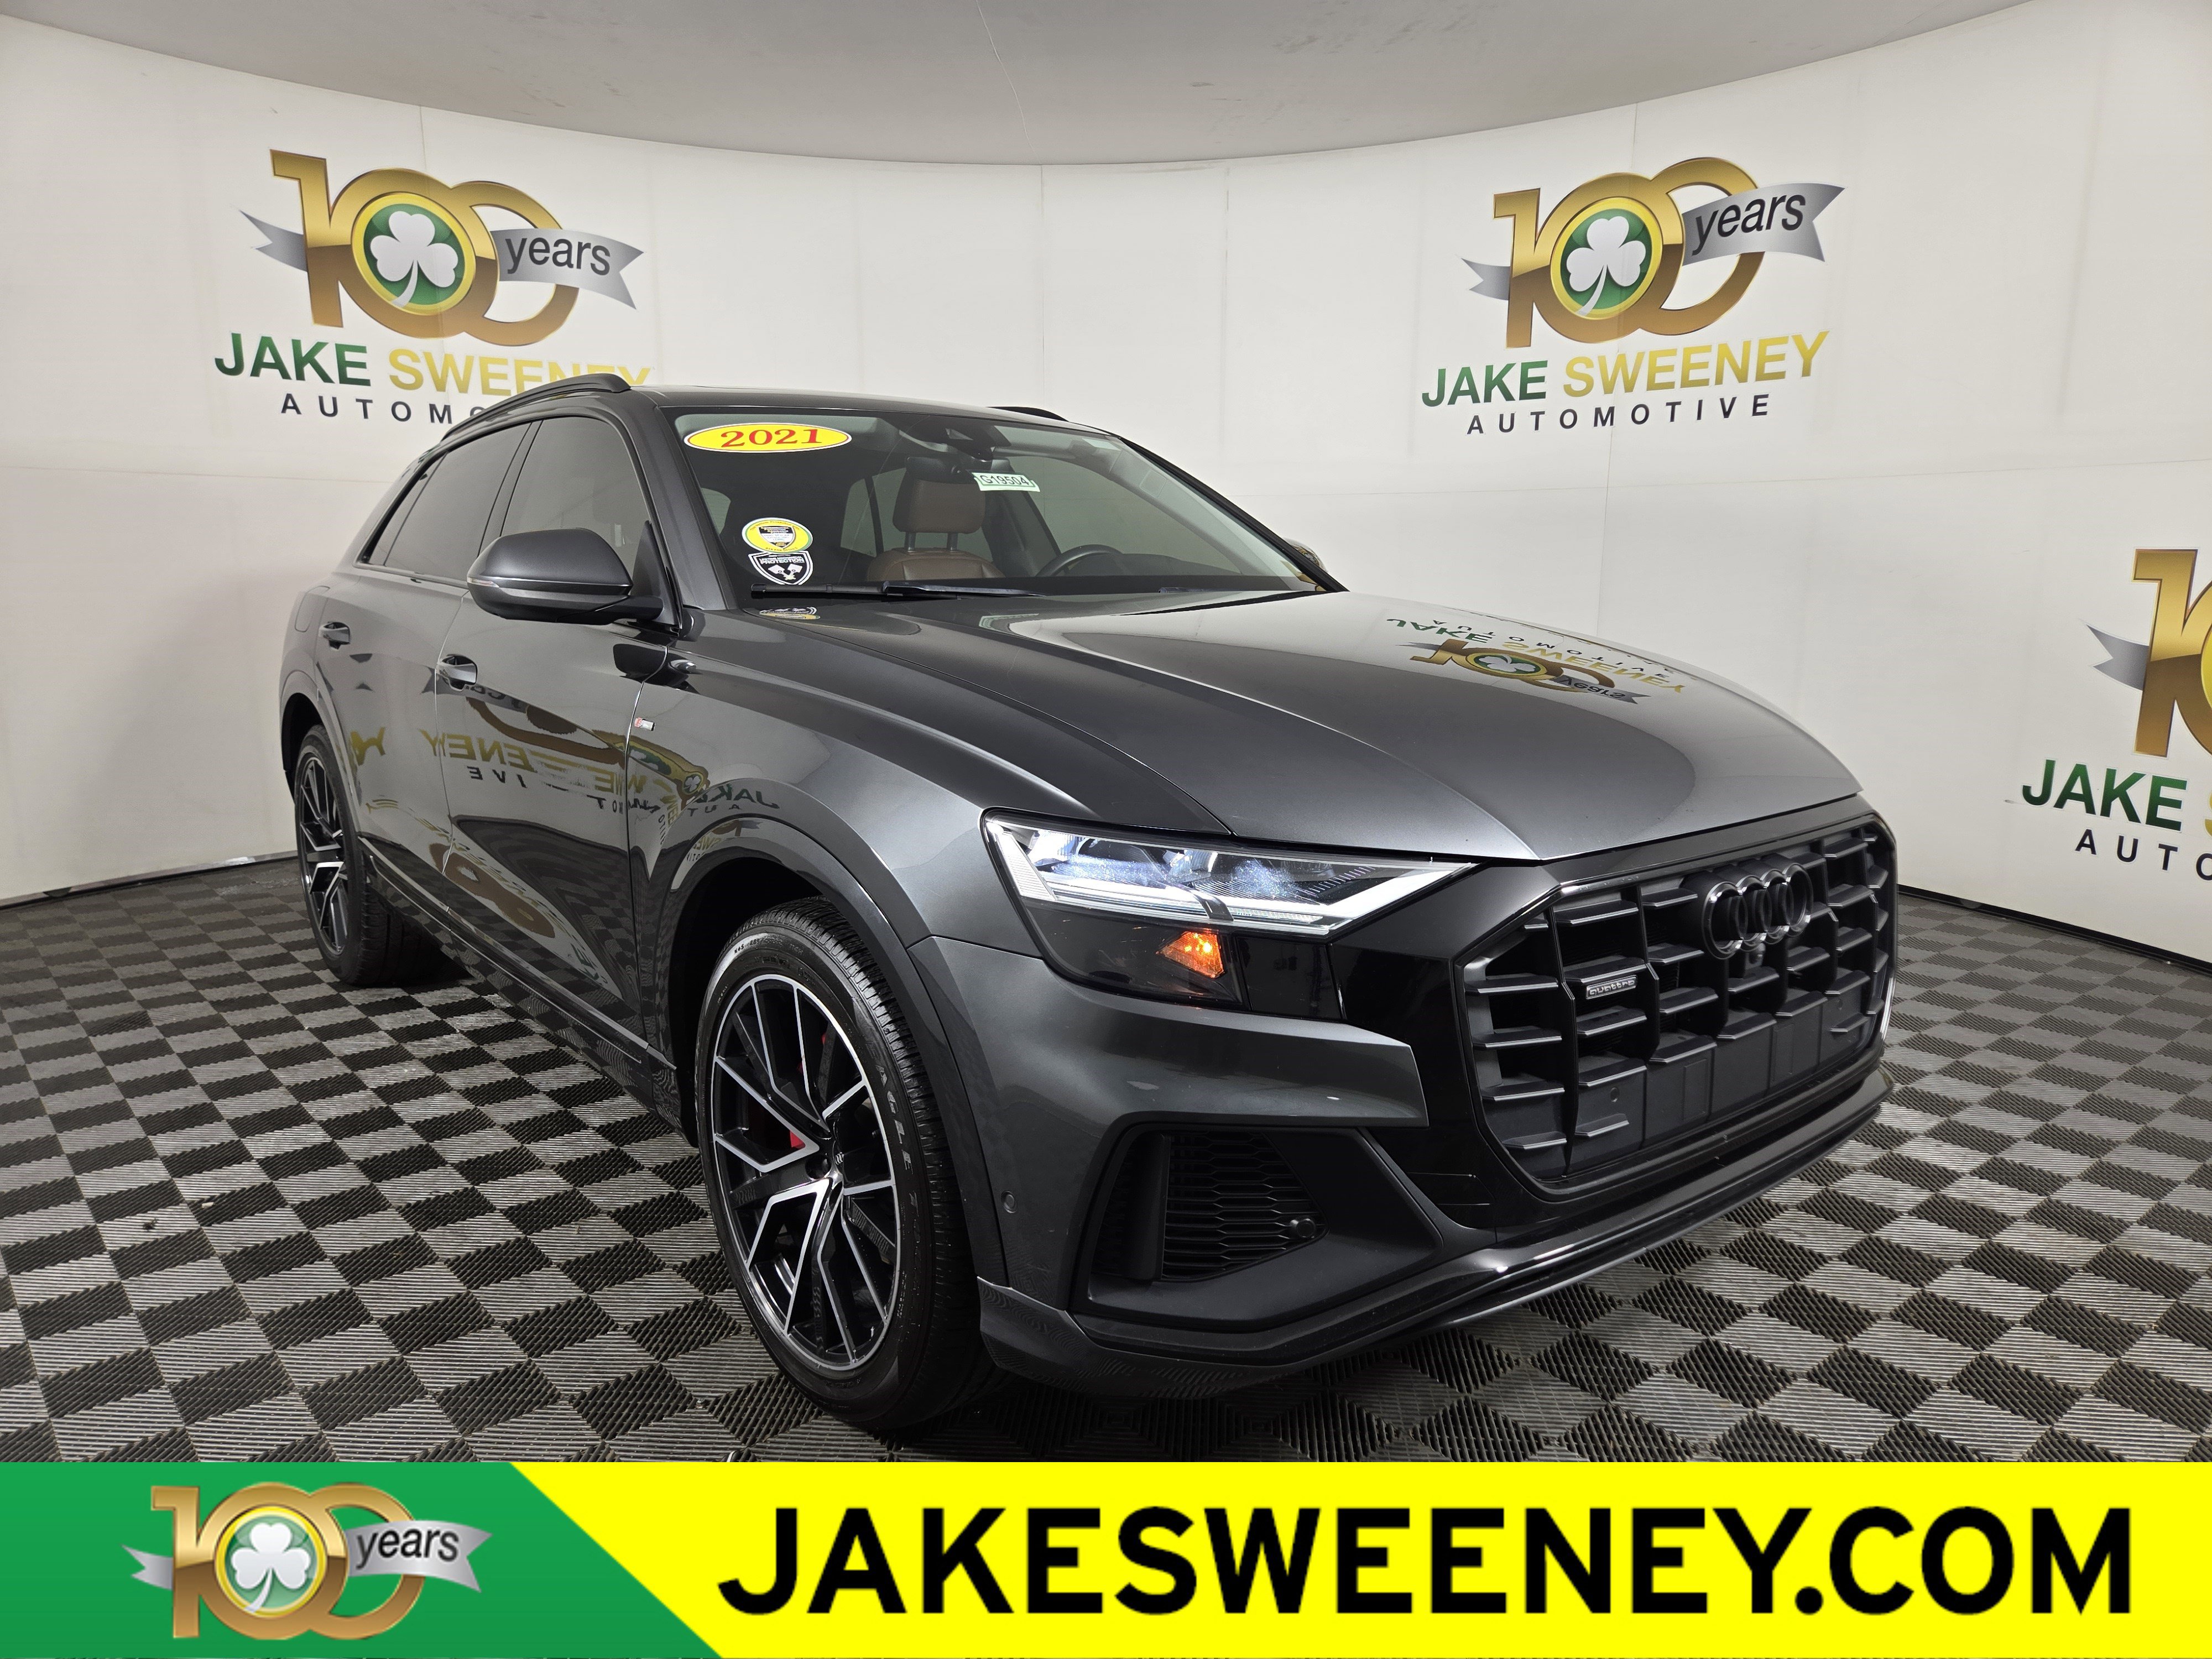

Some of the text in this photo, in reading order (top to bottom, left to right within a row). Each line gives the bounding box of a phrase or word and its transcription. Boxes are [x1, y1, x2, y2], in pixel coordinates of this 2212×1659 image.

[269, 149, 579, 346] 100
[1493, 156, 1766, 348] 100
[1692, 193, 1806, 255] years
[505, 236, 611, 275] years
[214, 333, 651, 397] JAKE SWEE
[1422, 331, 1830, 407] JAKE SWEENEY
[721, 429, 822, 447] 2021
[1466, 393, 1770, 435] AUTOMOTIVE
[980, 475, 1029, 486] G19504
[2022, 759, 2187, 831] JAKE
[1589, 979, 1635, 996] quattro
